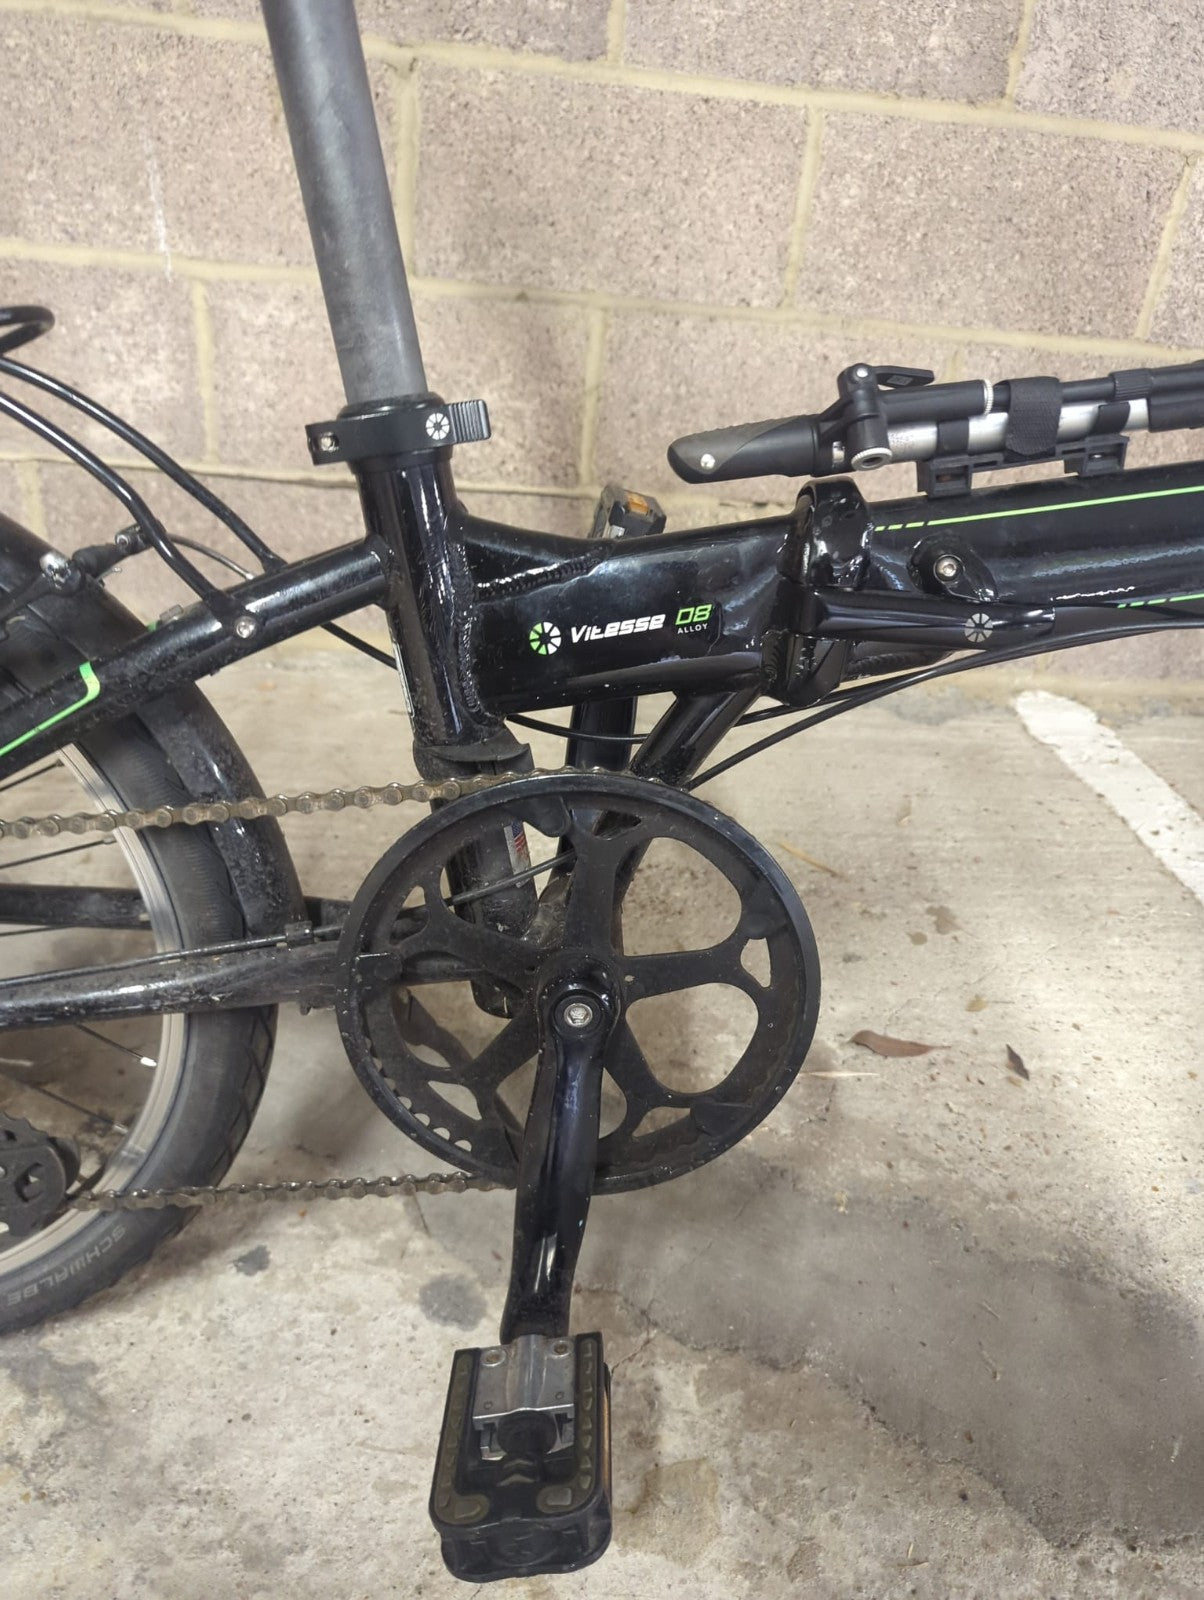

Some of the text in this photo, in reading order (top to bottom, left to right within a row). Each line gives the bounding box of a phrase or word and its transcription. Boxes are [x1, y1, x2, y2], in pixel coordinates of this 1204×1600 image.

[571, 614, 666, 643] Vitesse
[677, 623, 708, 634] ALLOY
[8, 1225, 126, 1305] SCHWALBE
